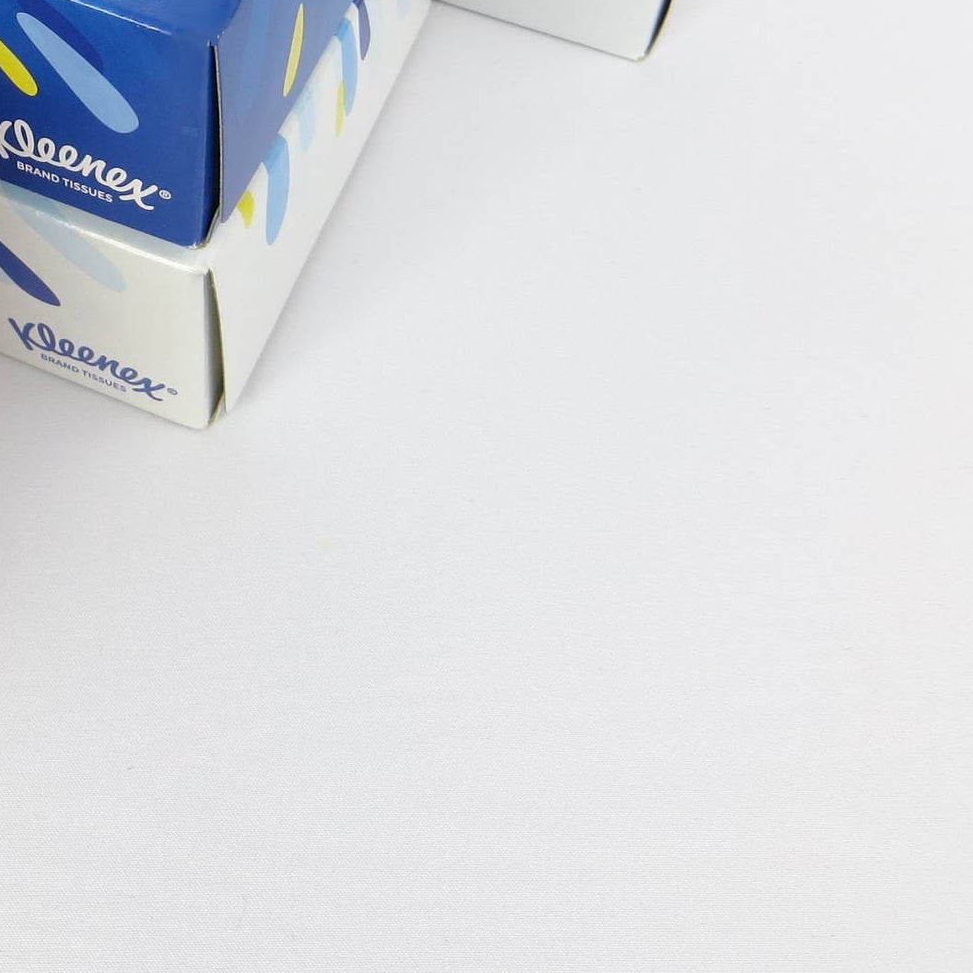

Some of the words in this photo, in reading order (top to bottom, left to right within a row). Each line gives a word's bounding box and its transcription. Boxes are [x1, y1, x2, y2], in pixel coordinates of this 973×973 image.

[16, 160, 60, 184] BRAND
[62, 178, 114, 203] TISSUES
[40, 352, 80, 373] BRAND
[81, 369, 127, 393] TISSUES
